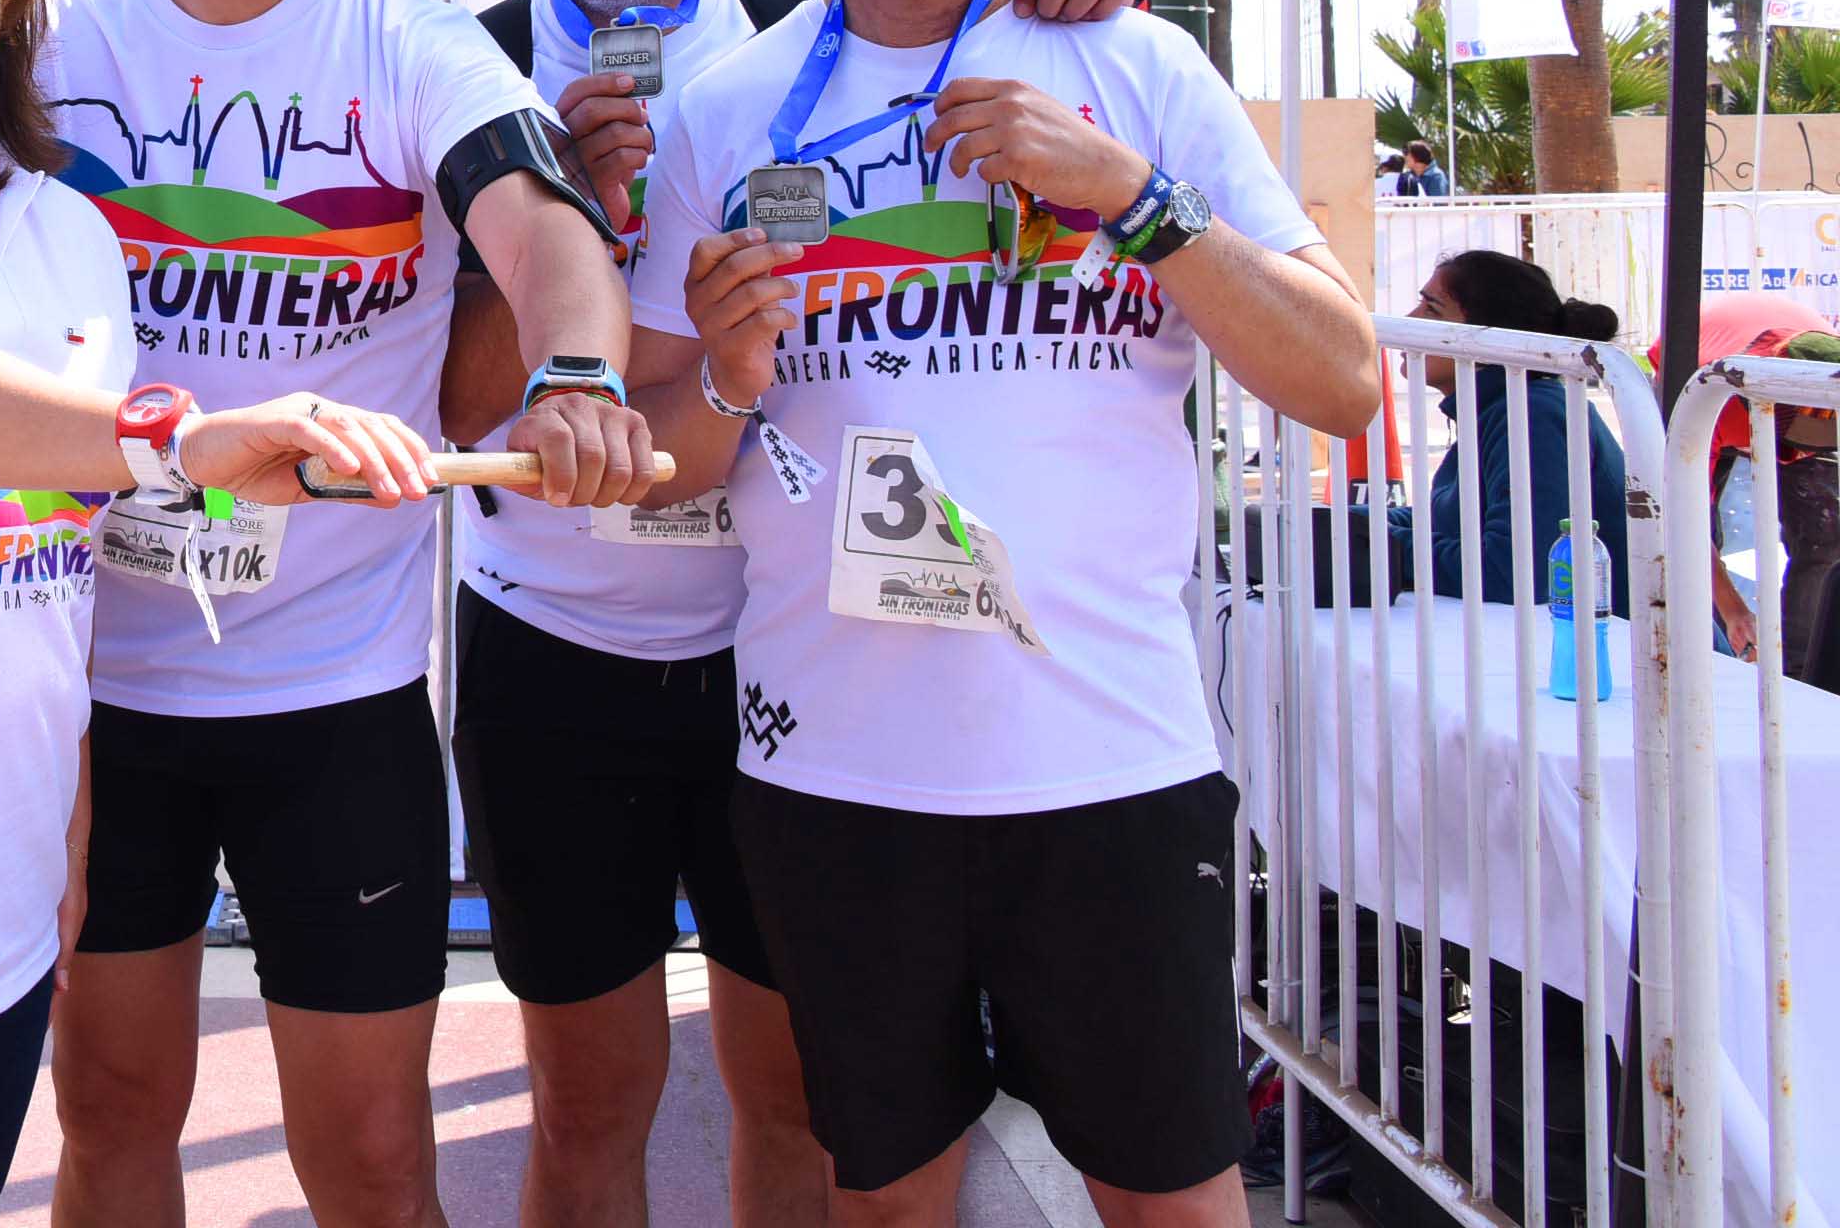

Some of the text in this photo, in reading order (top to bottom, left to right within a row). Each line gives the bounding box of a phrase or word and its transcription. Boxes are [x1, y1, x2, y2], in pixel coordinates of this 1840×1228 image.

[602, 52, 650, 67] FINISHER
[755, 206, 820, 219] SIN FRONTERAS
[120, 242, 424, 327] RONTERAS
[804, 265, 1165, 347] FRONTERAS
[630, 521, 711, 534] SIN FRONTERAS
[102, 545, 174, 574] SIN FRONTERAS
[878, 594, 970, 616] SIN FRONTERAS
